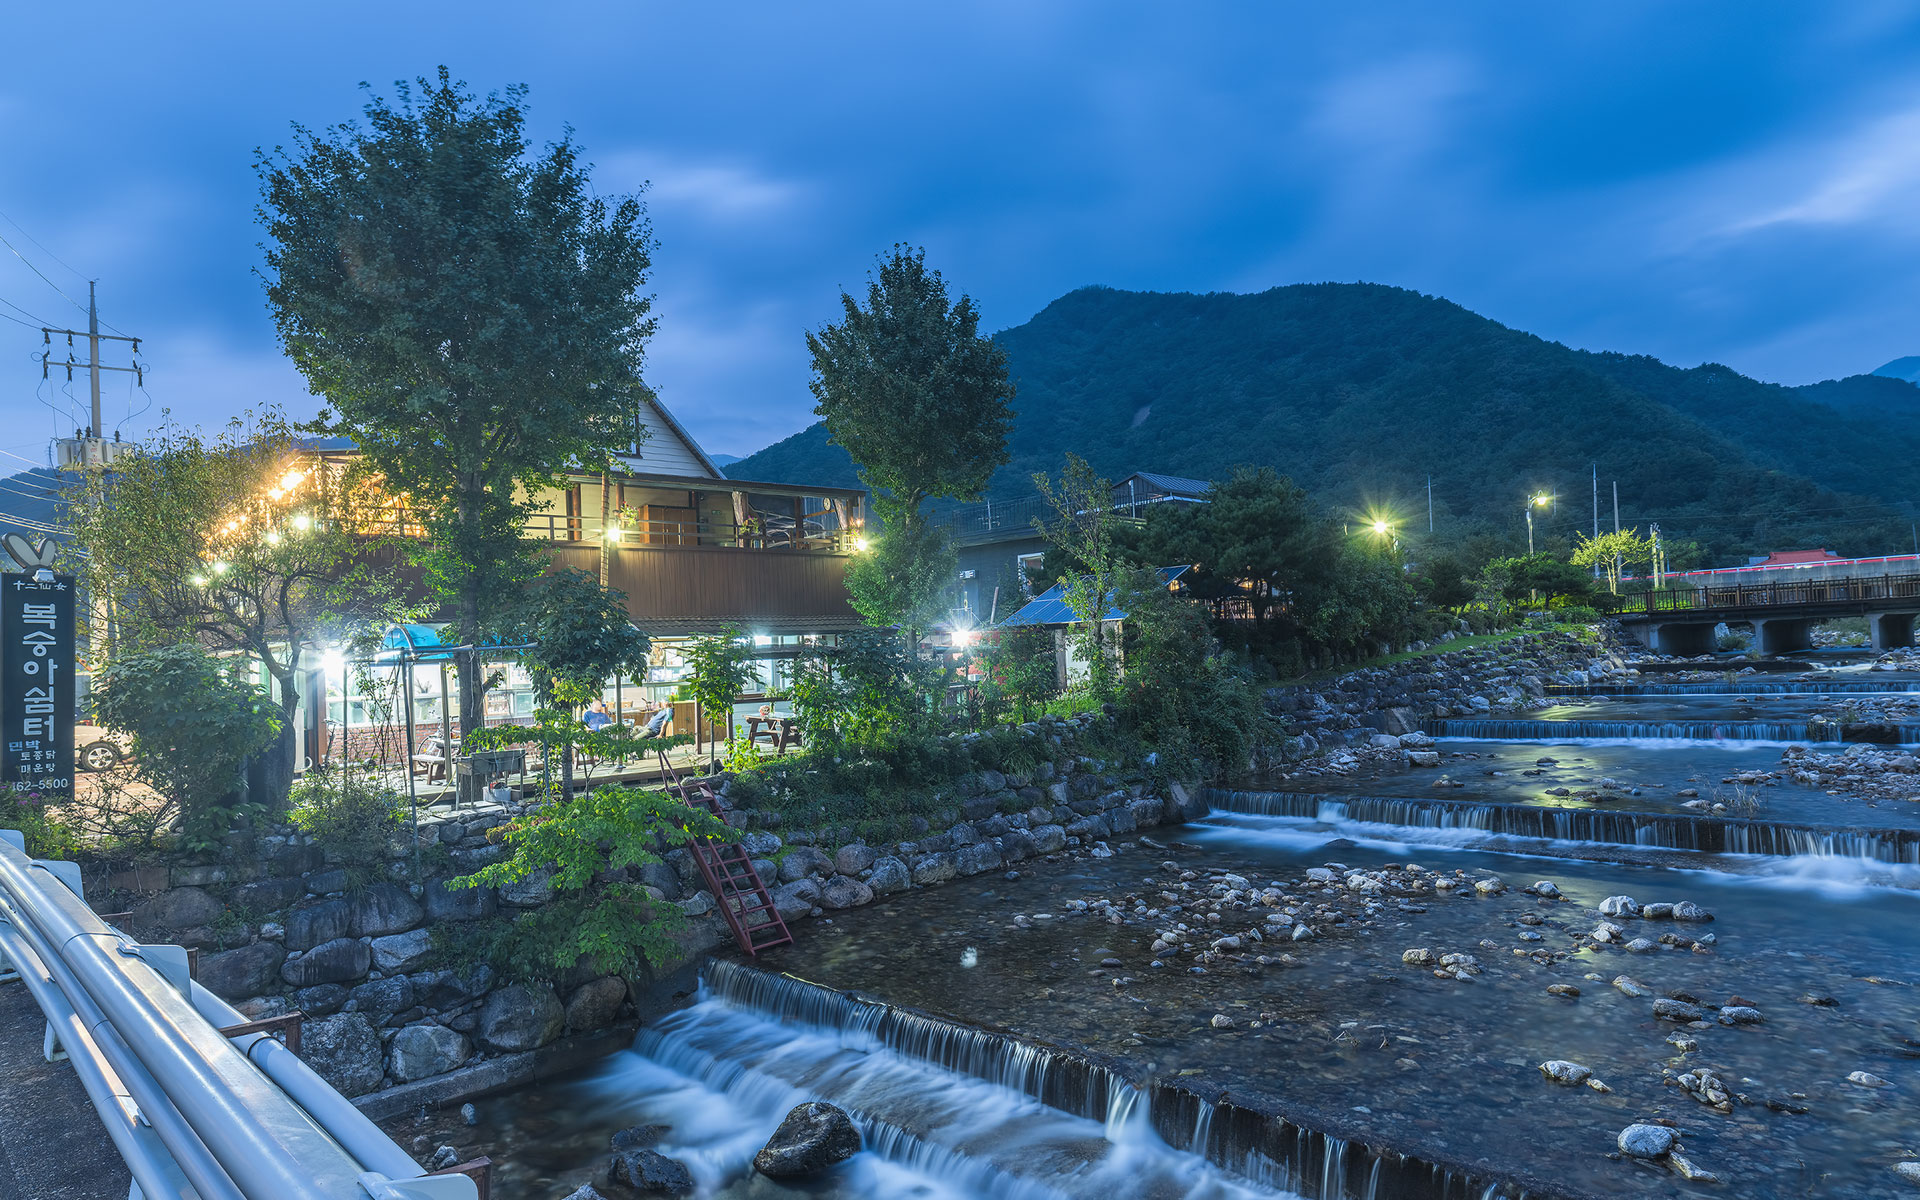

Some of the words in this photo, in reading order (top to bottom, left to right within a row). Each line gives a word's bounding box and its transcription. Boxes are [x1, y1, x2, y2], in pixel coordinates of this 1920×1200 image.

[22, 603, 58, 742] 복숭아쉼터
[8, 740, 41, 752] 민박
[21, 750, 56, 761] 토종닭
[21, 763, 56, 774] 매운탕
